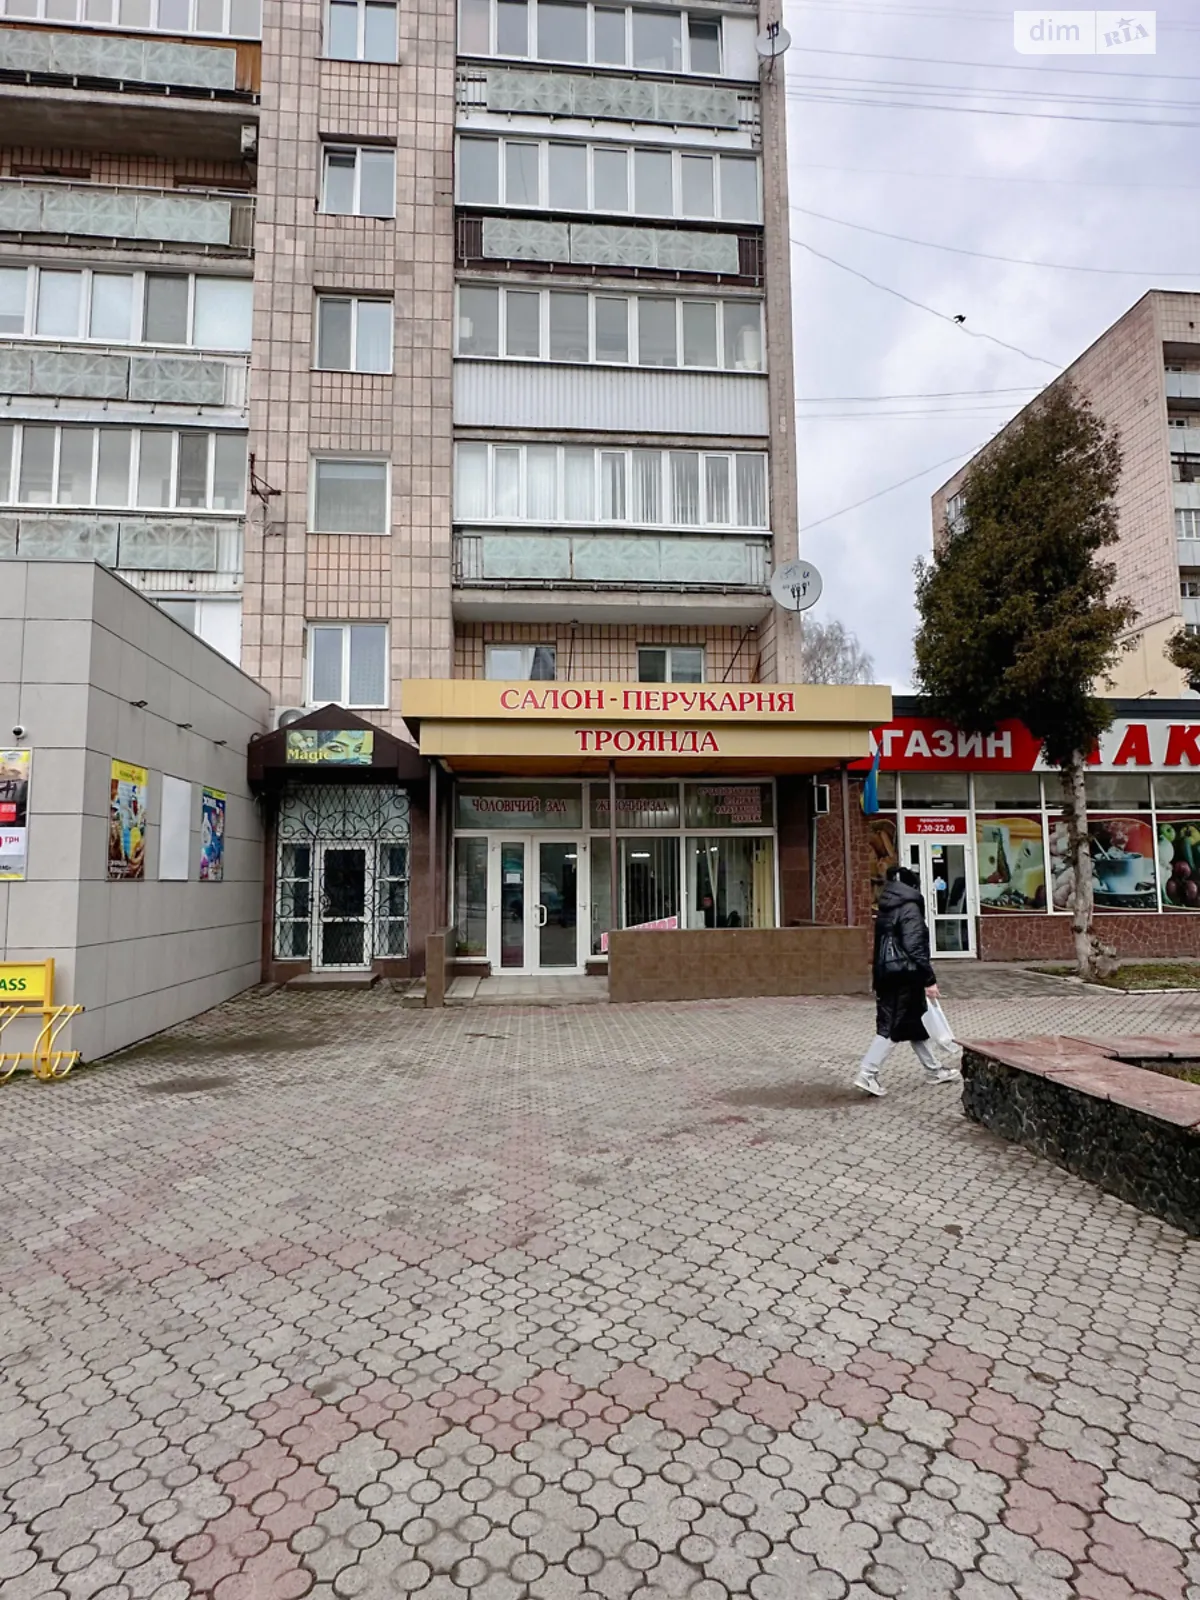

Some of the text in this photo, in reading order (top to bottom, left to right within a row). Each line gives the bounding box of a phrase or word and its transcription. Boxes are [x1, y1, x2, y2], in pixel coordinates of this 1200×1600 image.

[499, 689, 605, 710] САЛОН
[622, 690, 796, 712] ПЕРУКАРНЯ
[574, 730, 720, 753] ТРОЯНДА
[286, 748, 330, 763] Magic
[471, 796, 567, 812] ЧОЛОВІЧИЙ ЗАЛ
[650, 798, 669, 812] ЗАЛ
[4, 835, 20, 845] грн
